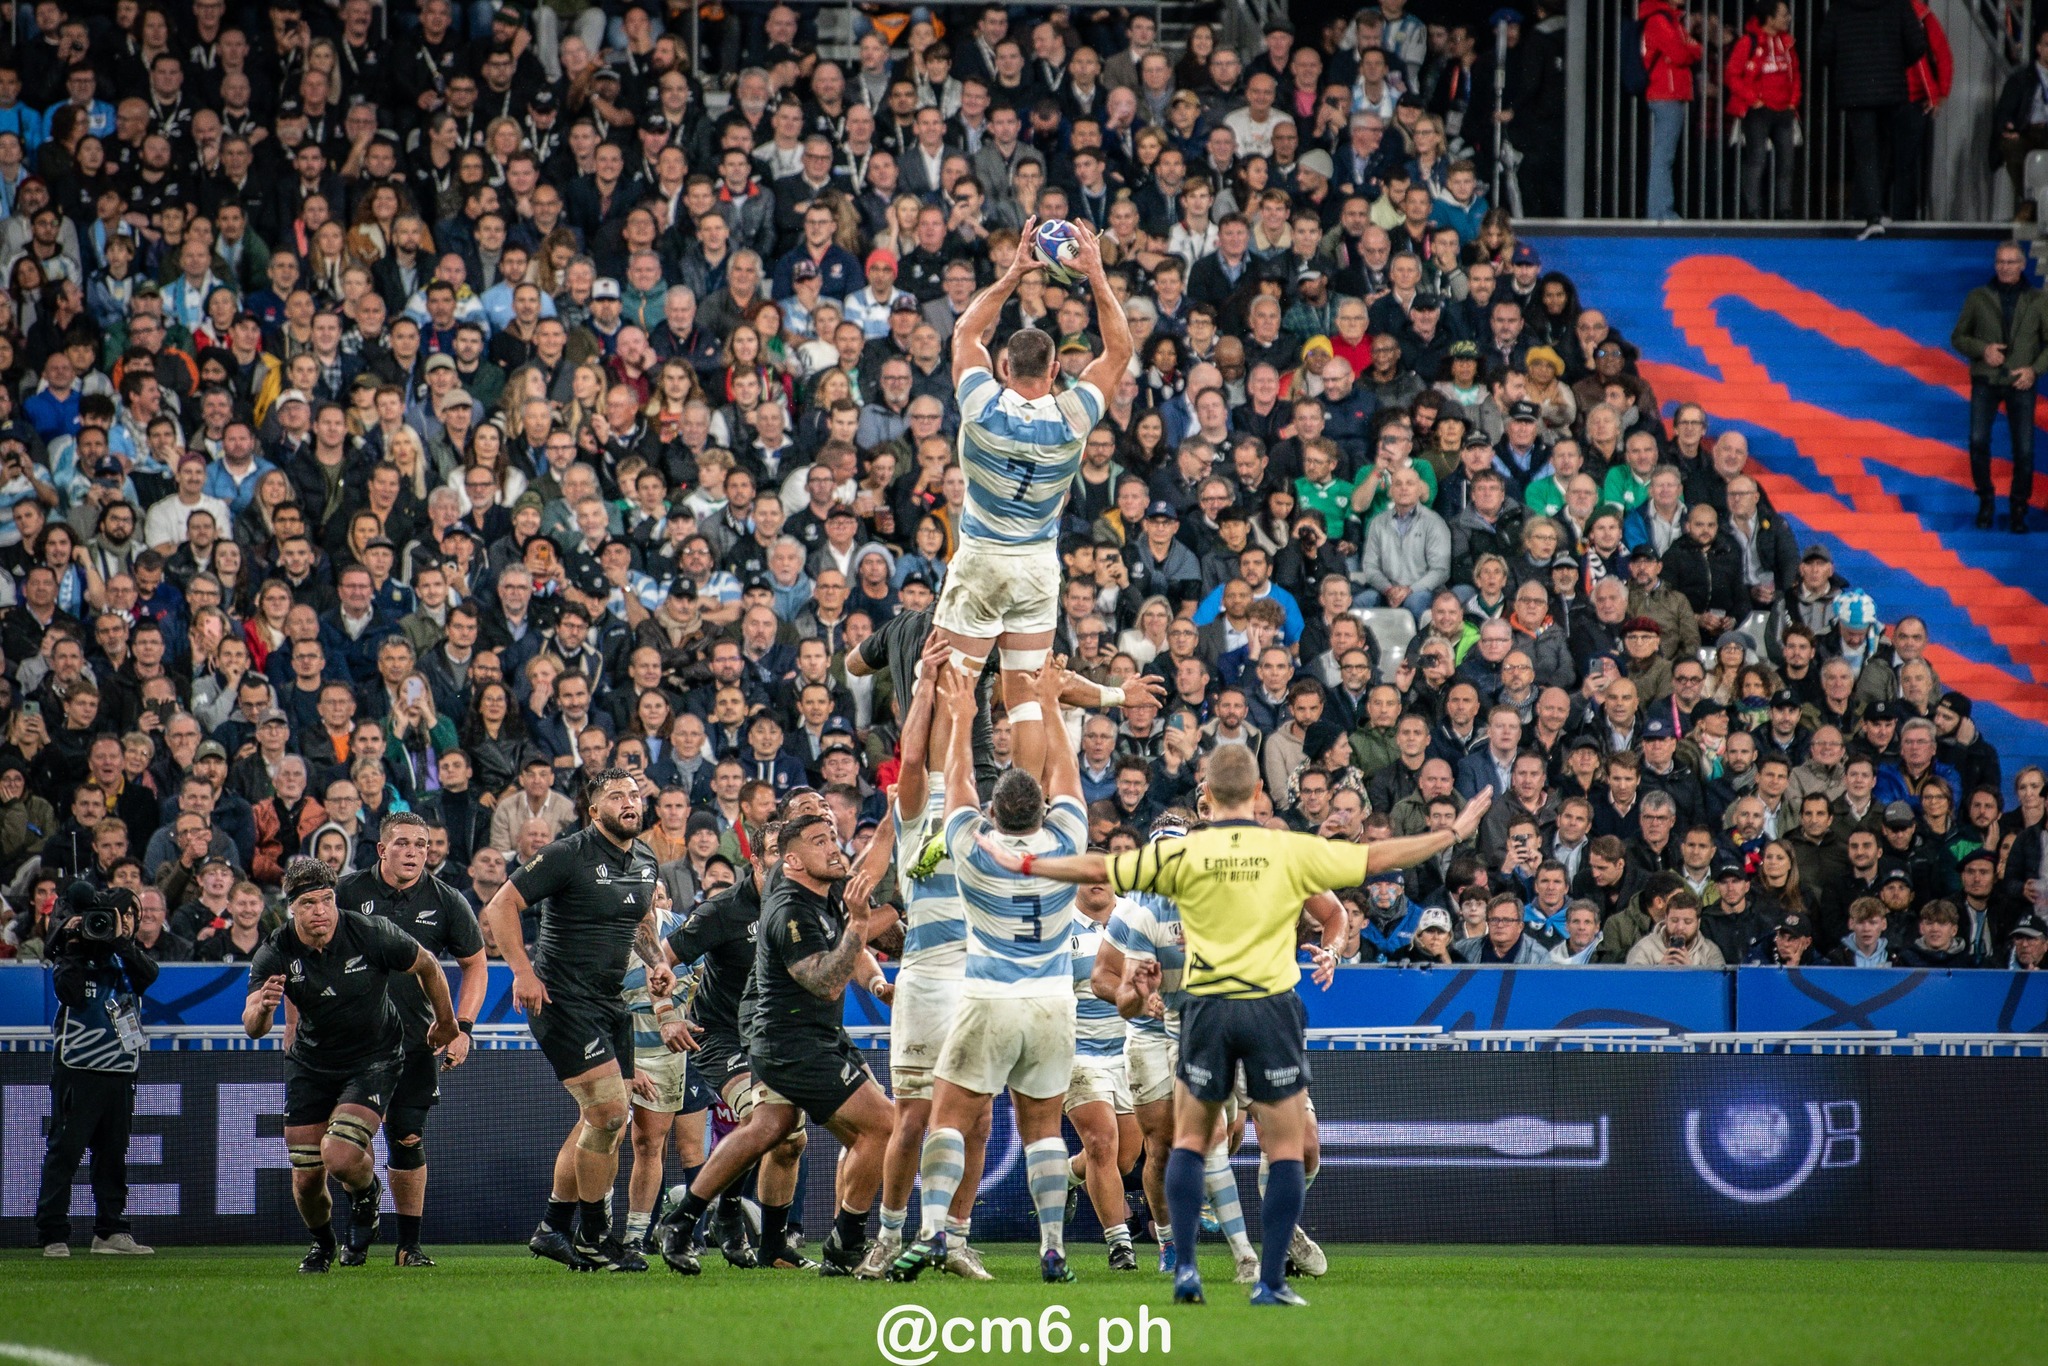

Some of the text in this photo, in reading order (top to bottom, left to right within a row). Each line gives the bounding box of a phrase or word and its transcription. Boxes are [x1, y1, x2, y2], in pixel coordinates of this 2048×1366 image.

[1006, 457, 1036, 502] 7
[1204, 856, 1270, 871] Emirates
[1012, 895, 1042, 943] 3
